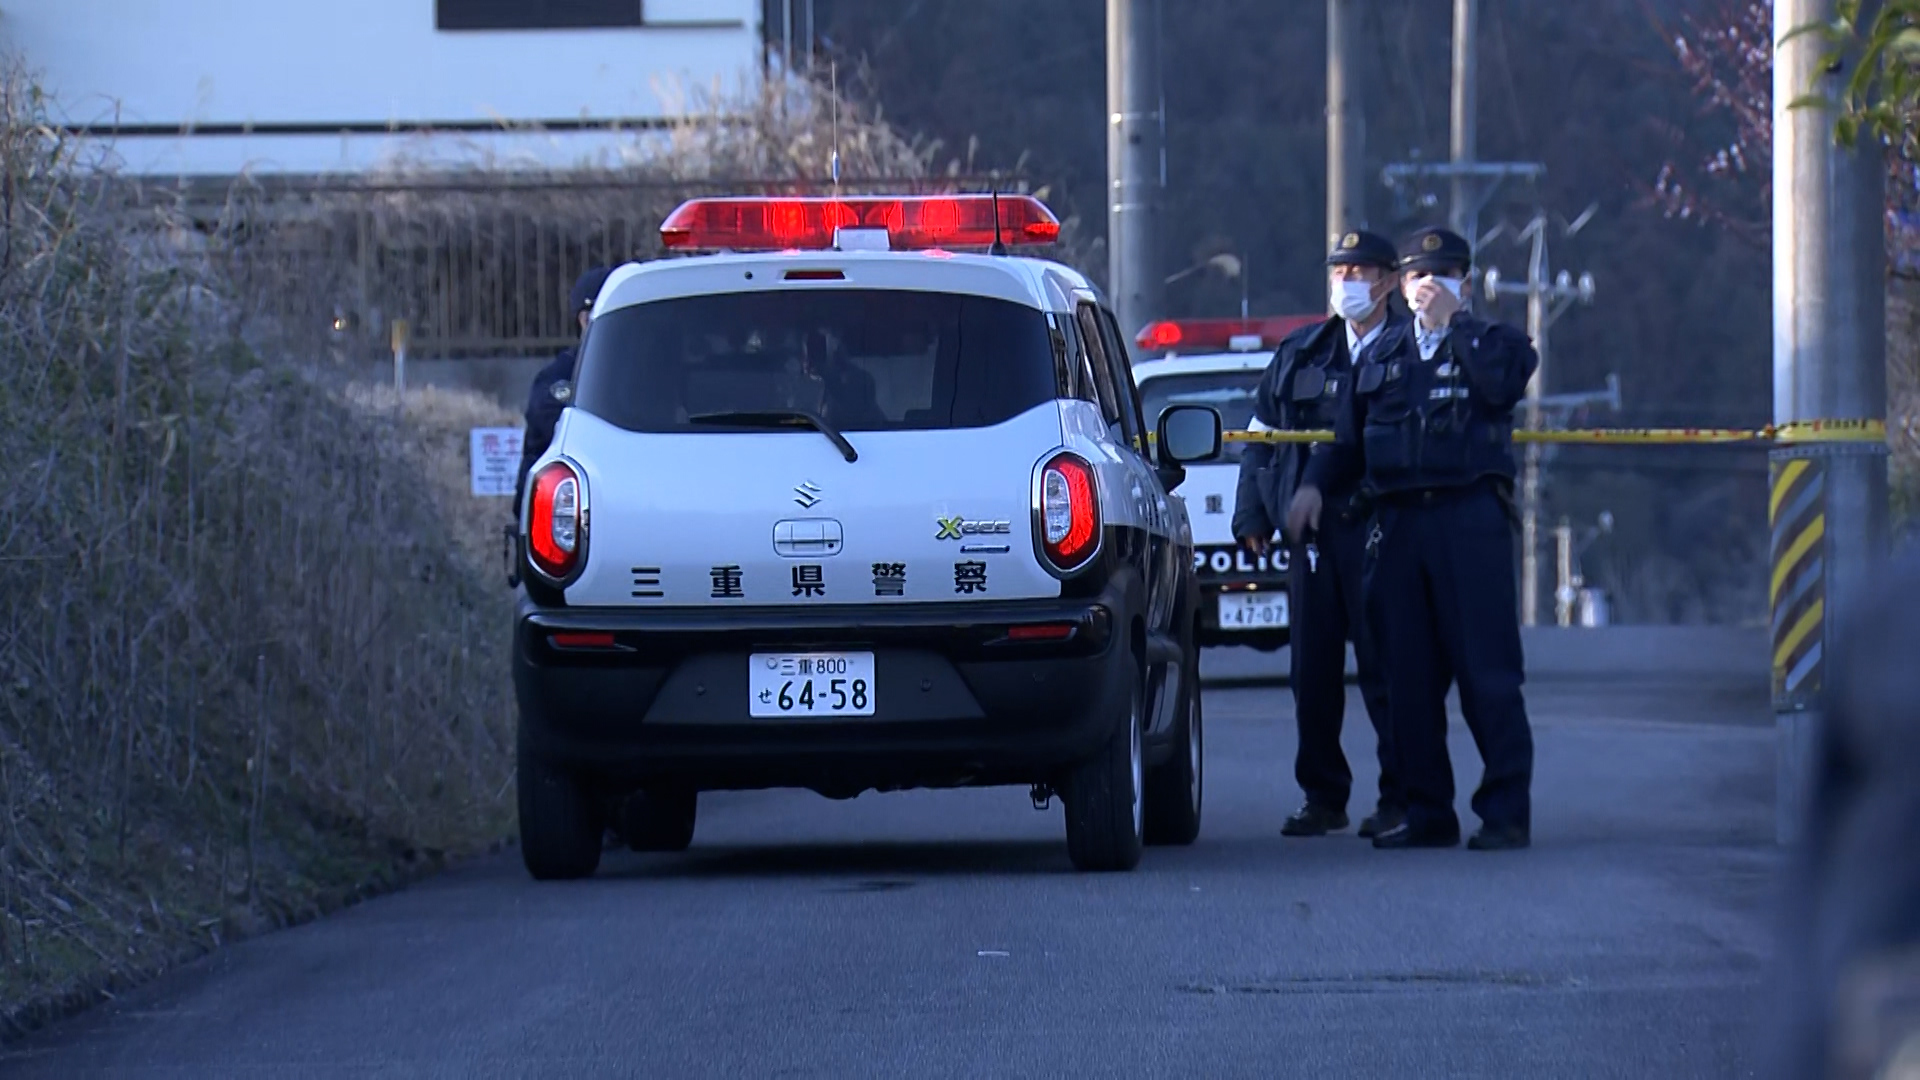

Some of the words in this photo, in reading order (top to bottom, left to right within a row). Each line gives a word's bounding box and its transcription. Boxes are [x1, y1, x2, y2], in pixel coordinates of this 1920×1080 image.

[1194, 550, 1291, 573] POLIC
[631, 559, 988, 598] 三重県警察
[1235, 605, 1284, 624] 47-07
[778, 679, 868, 710] 64-58
